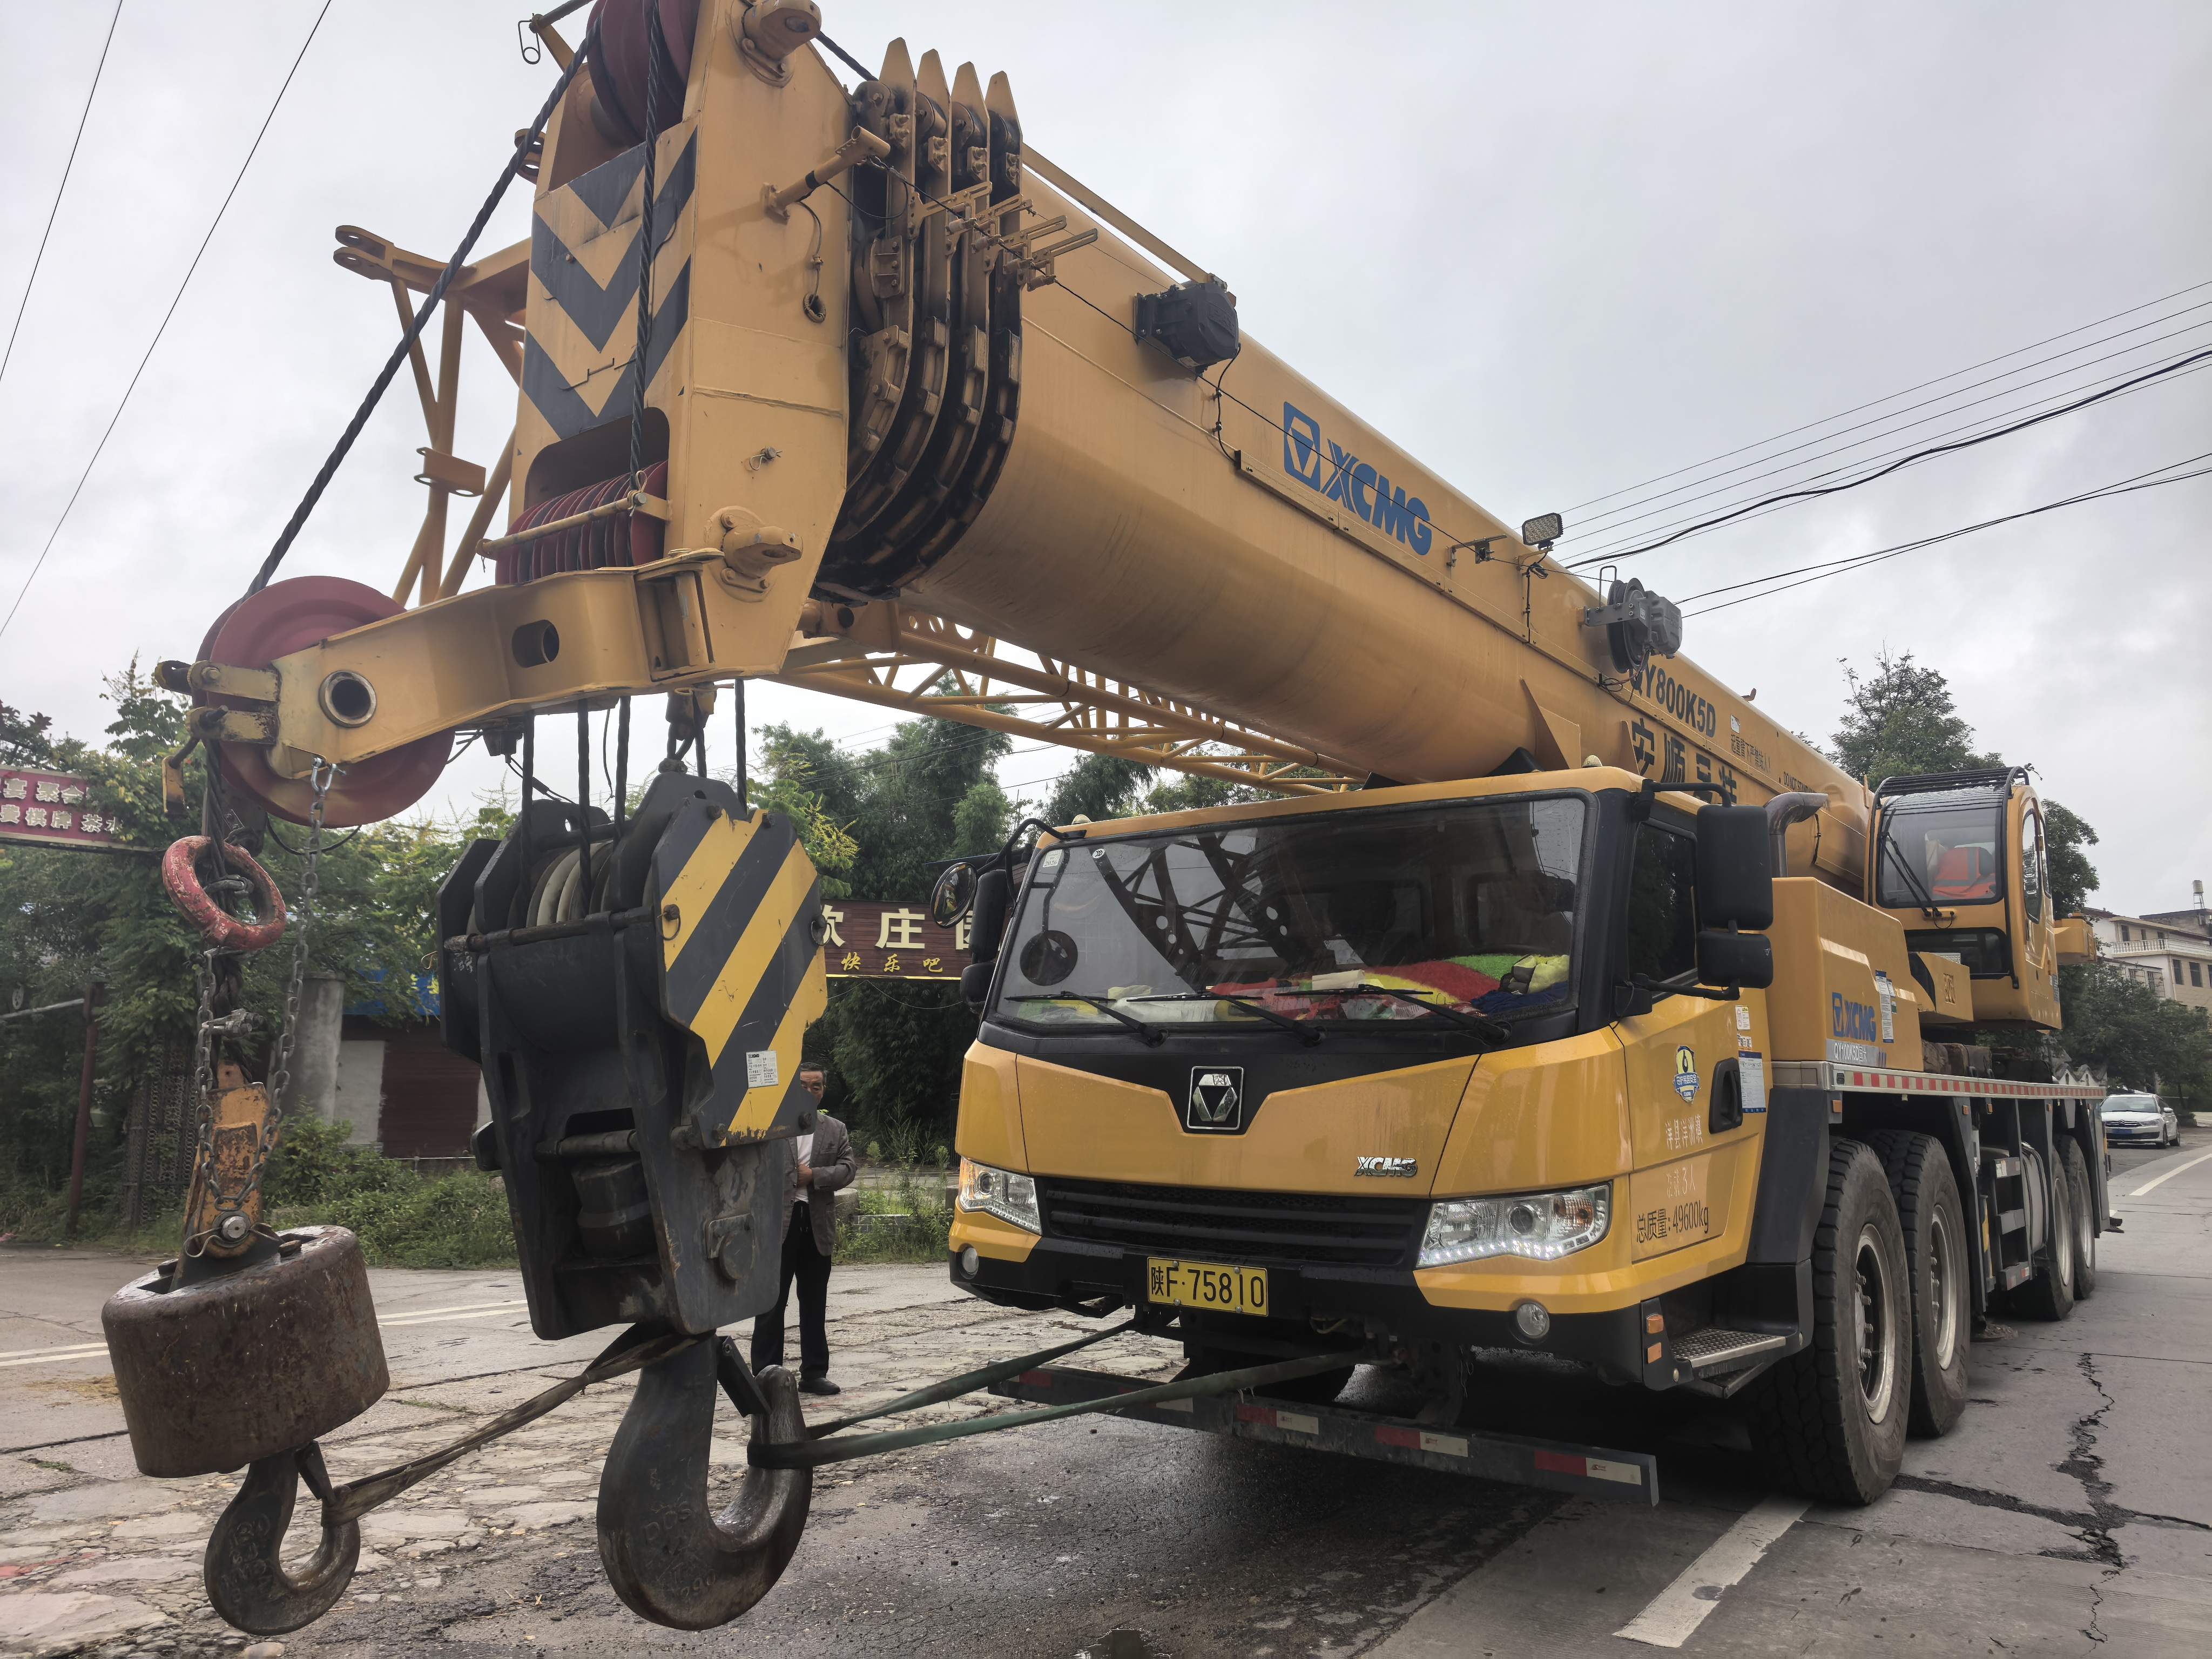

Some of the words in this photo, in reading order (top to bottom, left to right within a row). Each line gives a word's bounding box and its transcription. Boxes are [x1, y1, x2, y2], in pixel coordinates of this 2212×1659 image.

[1320, 438, 1432, 556] XCMG
[840, 952, 943, 973] 快乐吧
[1844, 1000, 1876, 1042] XCMG
[1354, 1156, 1418, 1177] XCMG
